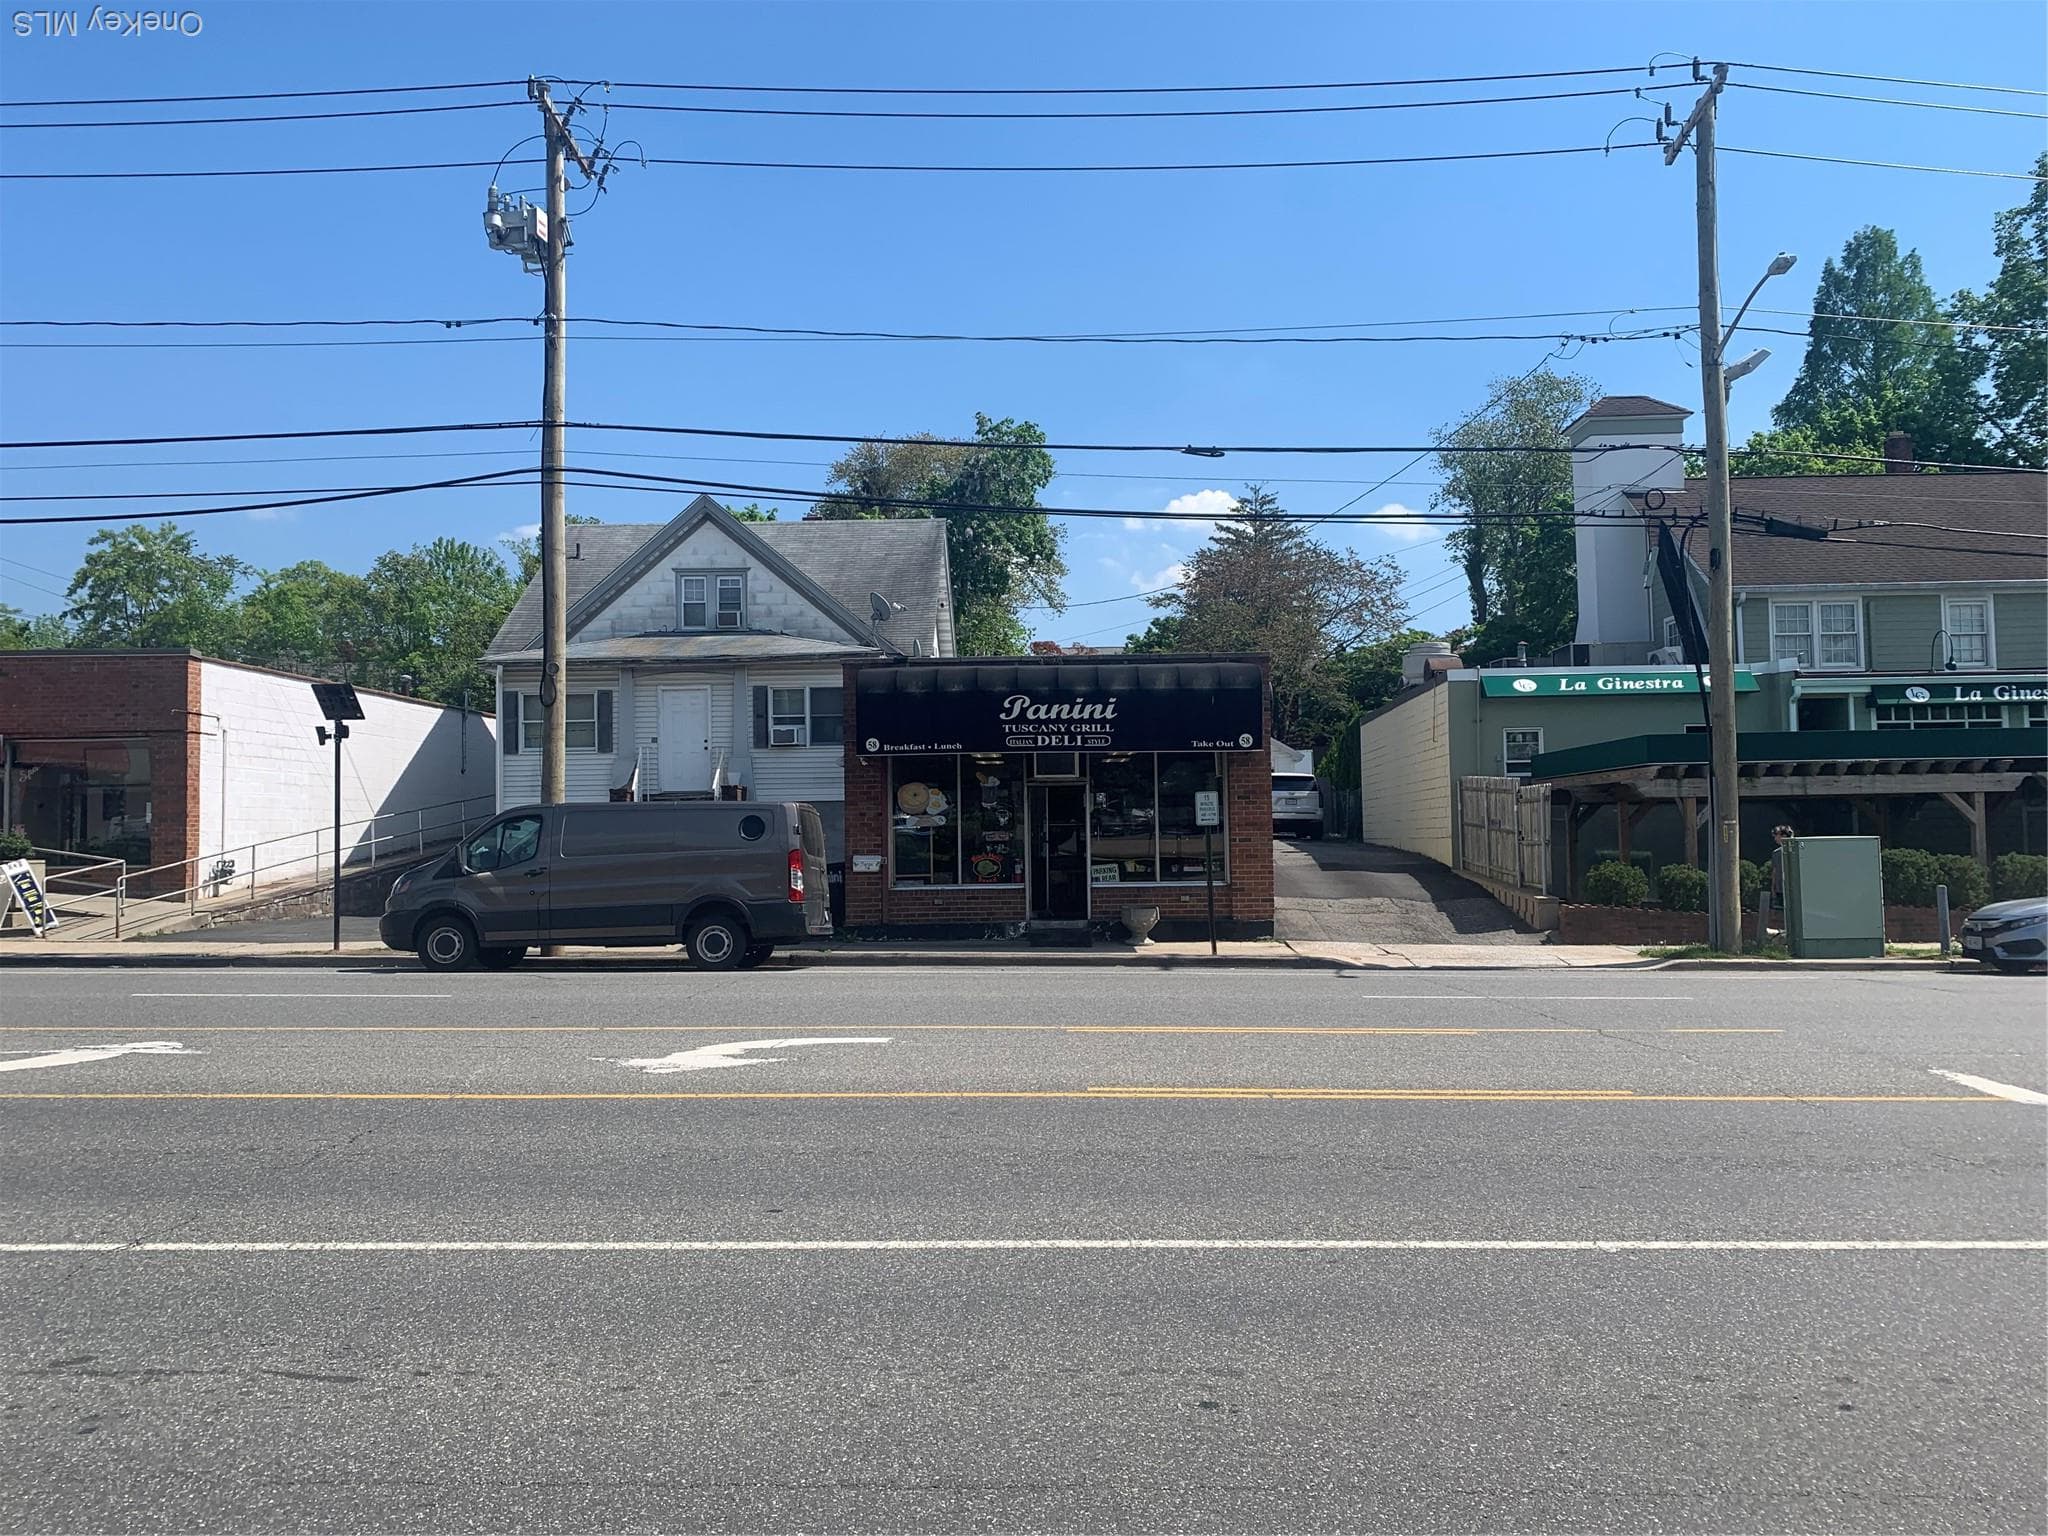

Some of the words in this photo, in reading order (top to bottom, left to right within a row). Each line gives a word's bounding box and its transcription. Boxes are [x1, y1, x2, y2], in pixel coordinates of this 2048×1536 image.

[1559, 678, 1587, 691] La
[1597, 677, 1684, 690] Ginestra
[1954, 686, 1983, 701] La
[999, 694, 1118, 720] Panini
[1002, 723, 1068, 733] TUSCANY
[1070, 723, 1115, 732] GRILL
[867, 739, 879, 751] 58
[883, 743, 926, 751] Breakfast
[934, 742, 962, 750] Lunch
[1037, 735, 1082, 746] DELI
[1240, 735, 1252, 747] 58
